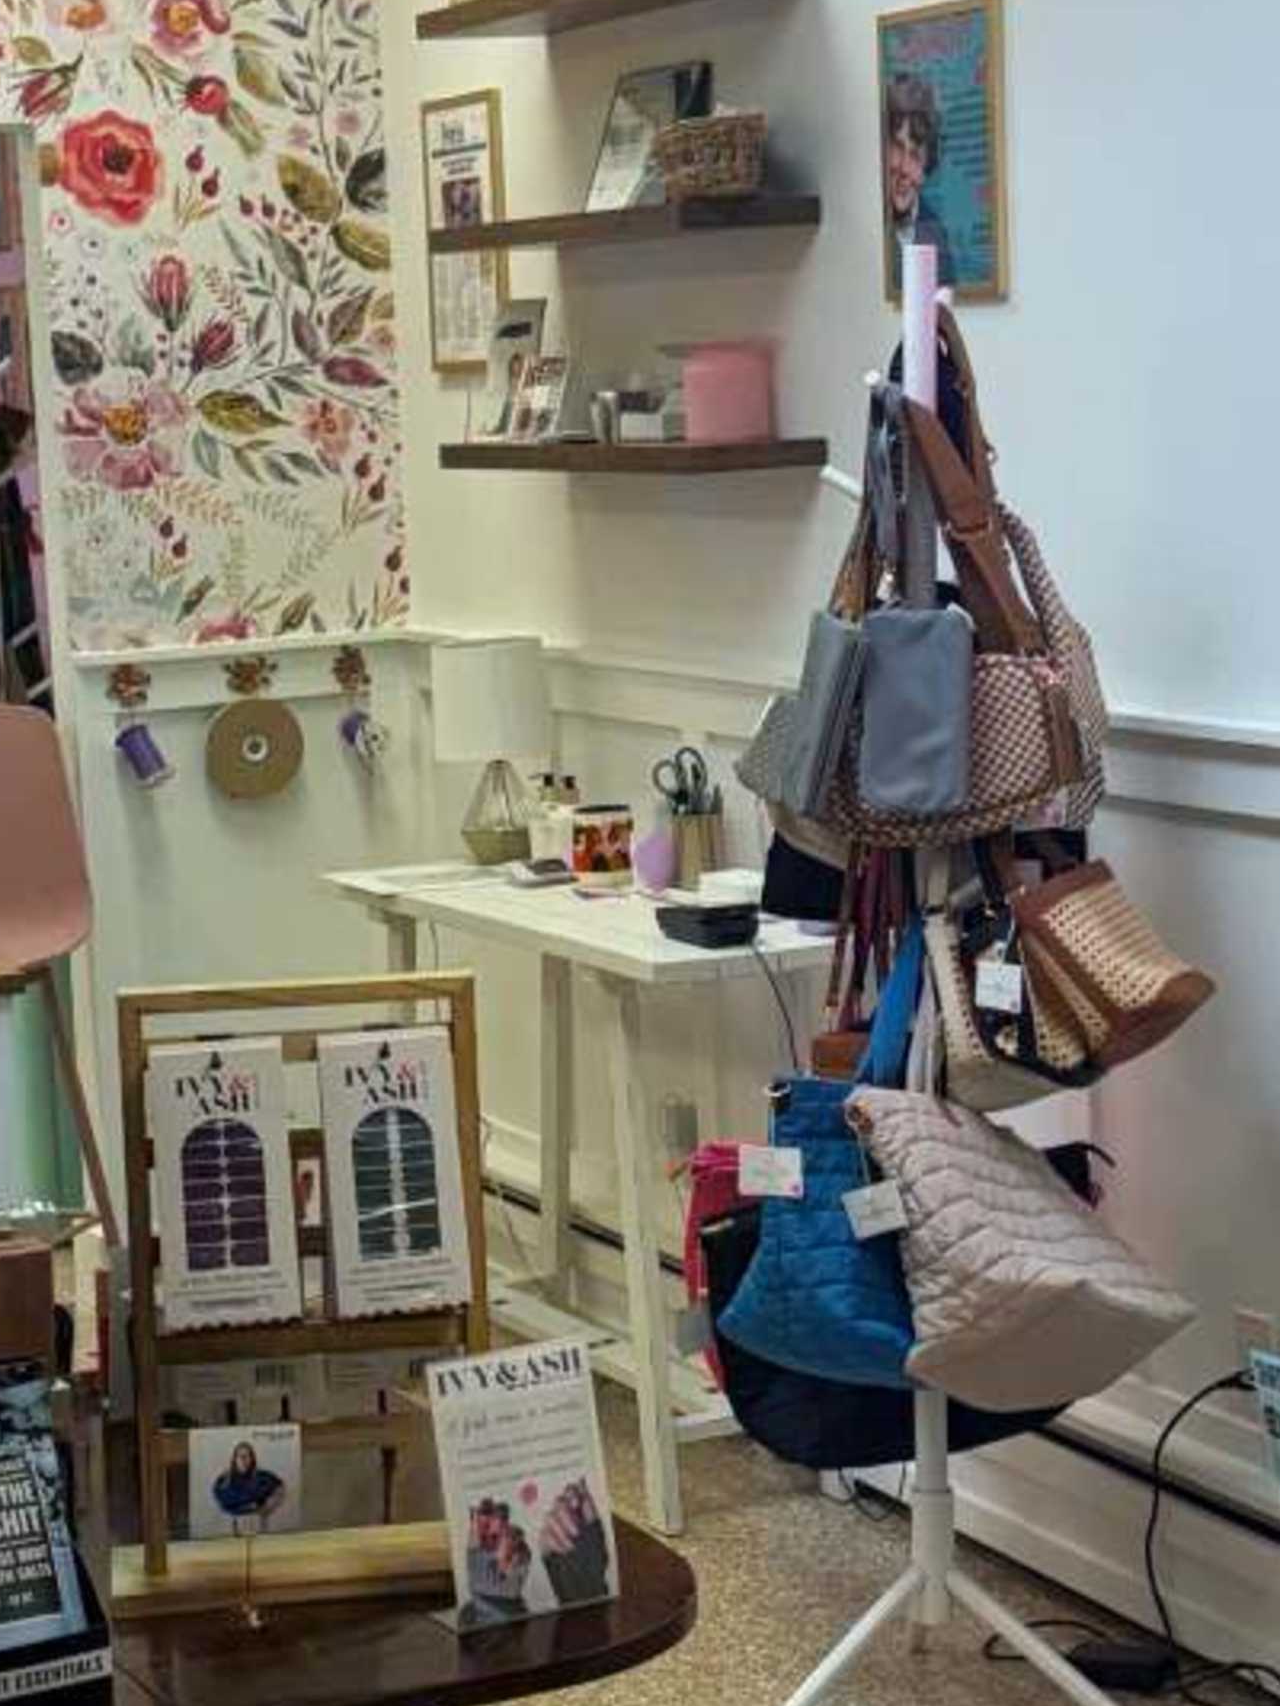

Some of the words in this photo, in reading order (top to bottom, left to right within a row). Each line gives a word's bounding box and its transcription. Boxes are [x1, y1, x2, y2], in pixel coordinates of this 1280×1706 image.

[192, 1093, 251, 1116] ASH
[363, 1082, 418, 1106] ASH
[0, 1479, 36, 1504] THE
[17, 1562, 53, 1580] SALTS
[15, 1655, 105, 1690] ESSENTIALS
